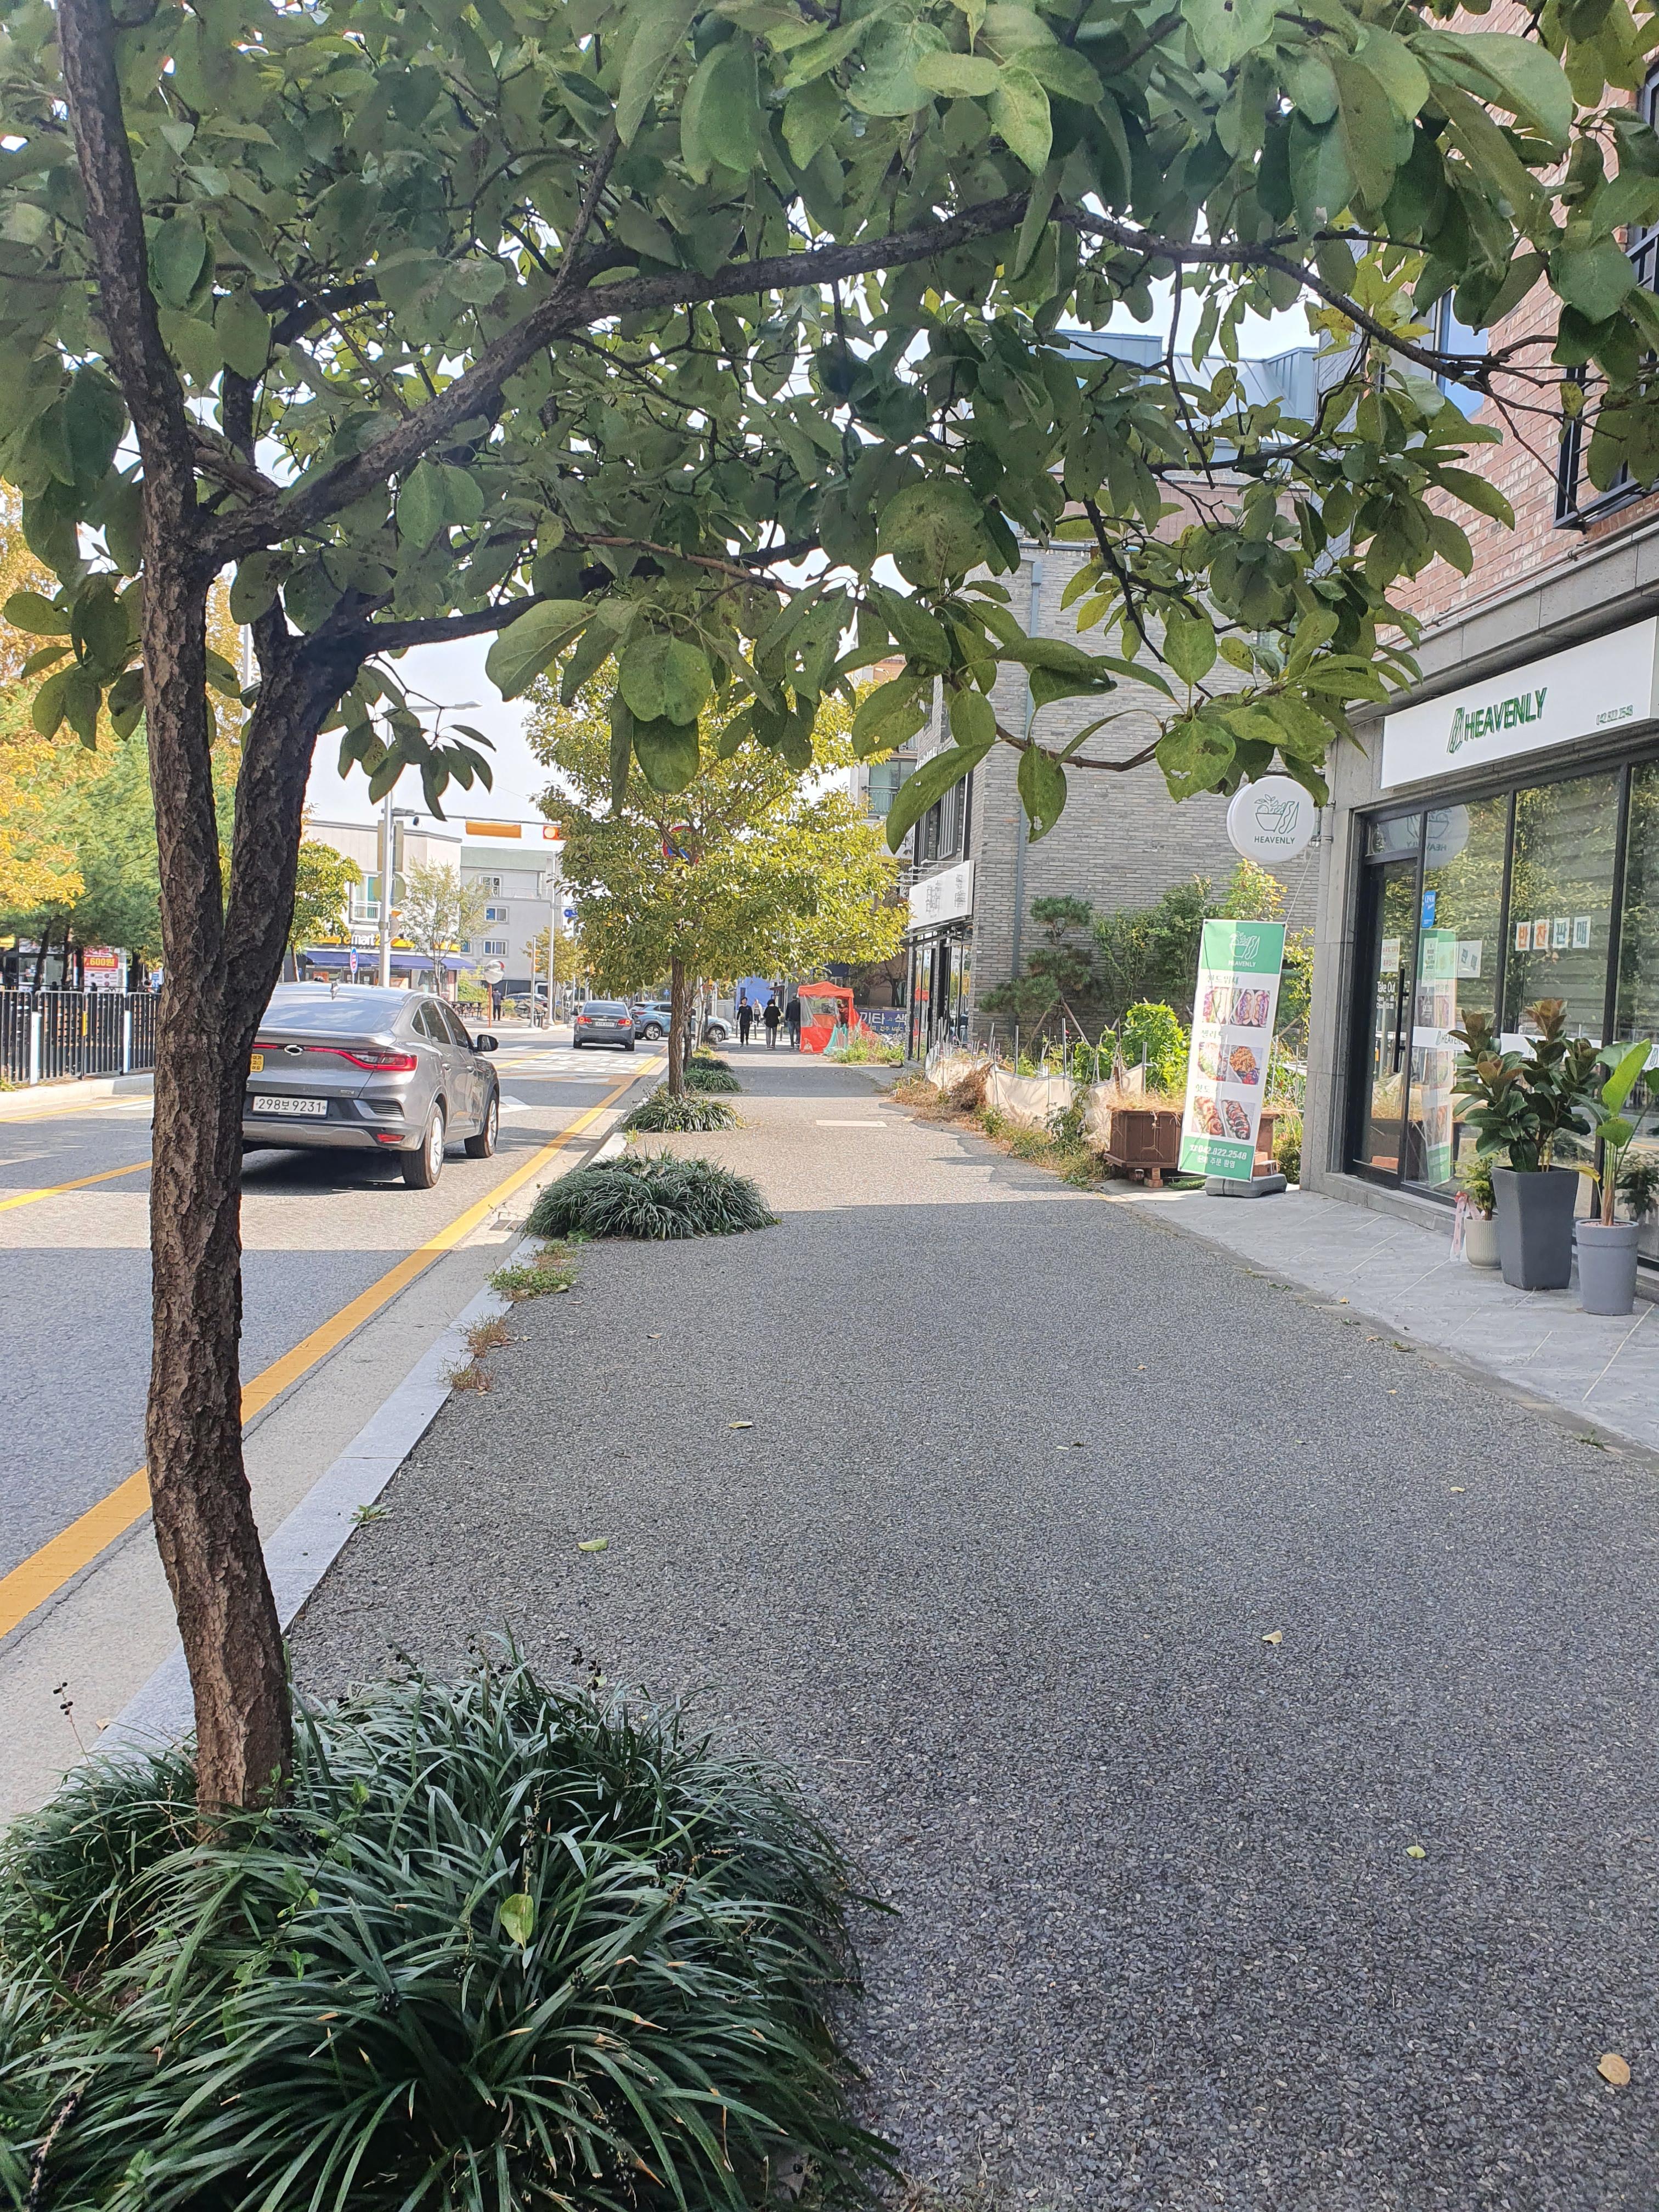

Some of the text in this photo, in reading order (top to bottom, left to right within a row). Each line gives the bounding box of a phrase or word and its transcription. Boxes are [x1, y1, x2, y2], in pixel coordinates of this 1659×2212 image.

[1464, 687, 1548, 742] HEAVENLY
[1254, 836, 1295, 844] HEAVENLY
[1376, 981, 1396, 993] Take Out
[258, 1098, 321, 1113] 298보 9231
[1210, 1157, 1222, 1166] 주문
